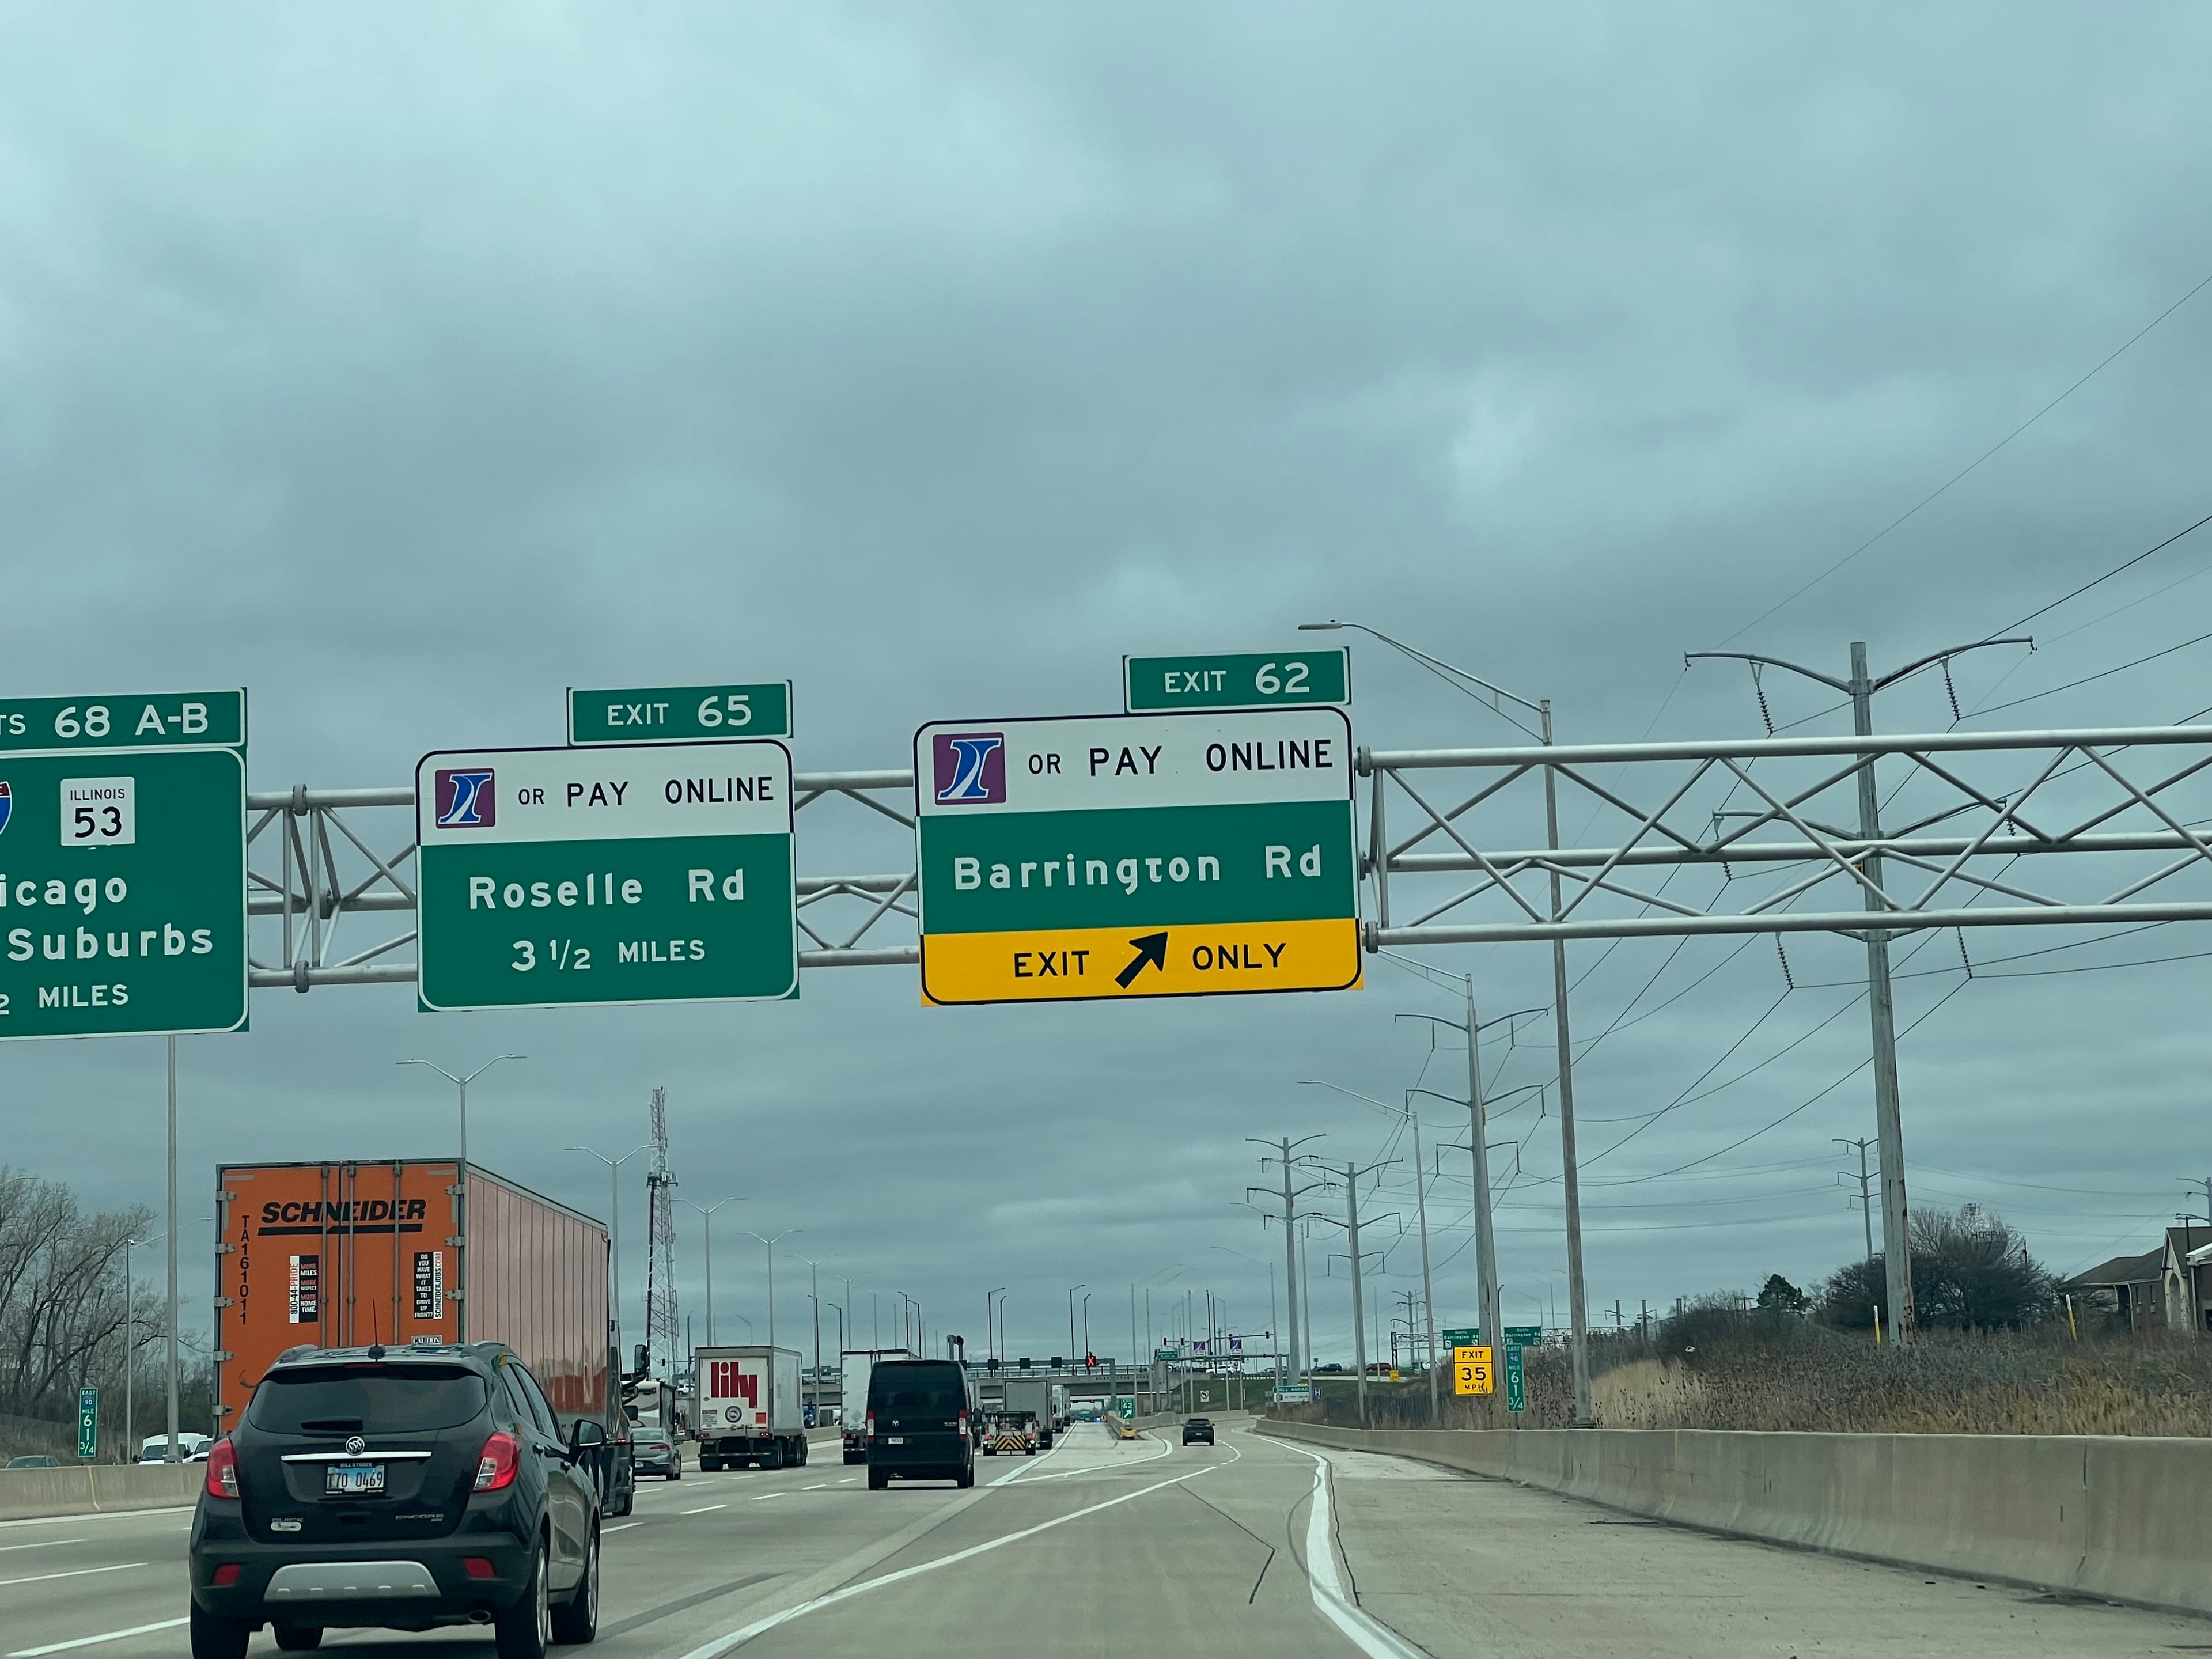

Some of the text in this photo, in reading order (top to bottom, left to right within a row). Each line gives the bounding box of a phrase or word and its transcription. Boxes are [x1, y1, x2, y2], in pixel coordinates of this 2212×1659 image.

[1165, 662, 1310, 694] EXIT 62
[55, 706, 110, 738] 68
[135, 703, 208, 735] A-B
[608, 695, 752, 727] EXIT 65
[1028, 754, 1061, 774] OR
[1090, 746, 1162, 777] PAY
[1206, 740, 1332, 772] ONLINE
[70, 789, 125, 800] ILLINOIS
[519, 789, 544, 804] OR
[567, 781, 628, 807] PAY
[665, 777, 774, 804] ONLINE
[74, 806, 122, 838] 53
[954, 844, 1321, 895] Barrington Rd
[470, 868, 744, 909] Roselle Rd
[7, 923, 213, 961] Suburbs
[619, 940, 705, 963] MILES
[1014, 942, 1286, 978] EXIT ONLY
[39, 984, 128, 1008] MILES
[262, 1199, 426, 1223] SCHNEIDER
[240, 1215, 249, 1324] TA161011
[1462, 1351, 1484, 1359] EXIT
[711, 1362, 757, 1408] lily
[1461, 1367, 1486, 1381] 35
[1509, 1397, 1523, 1410] 3/4
[80, 1442, 94, 1455] 3/4
[355, 1472, 382, 1487] 0469
